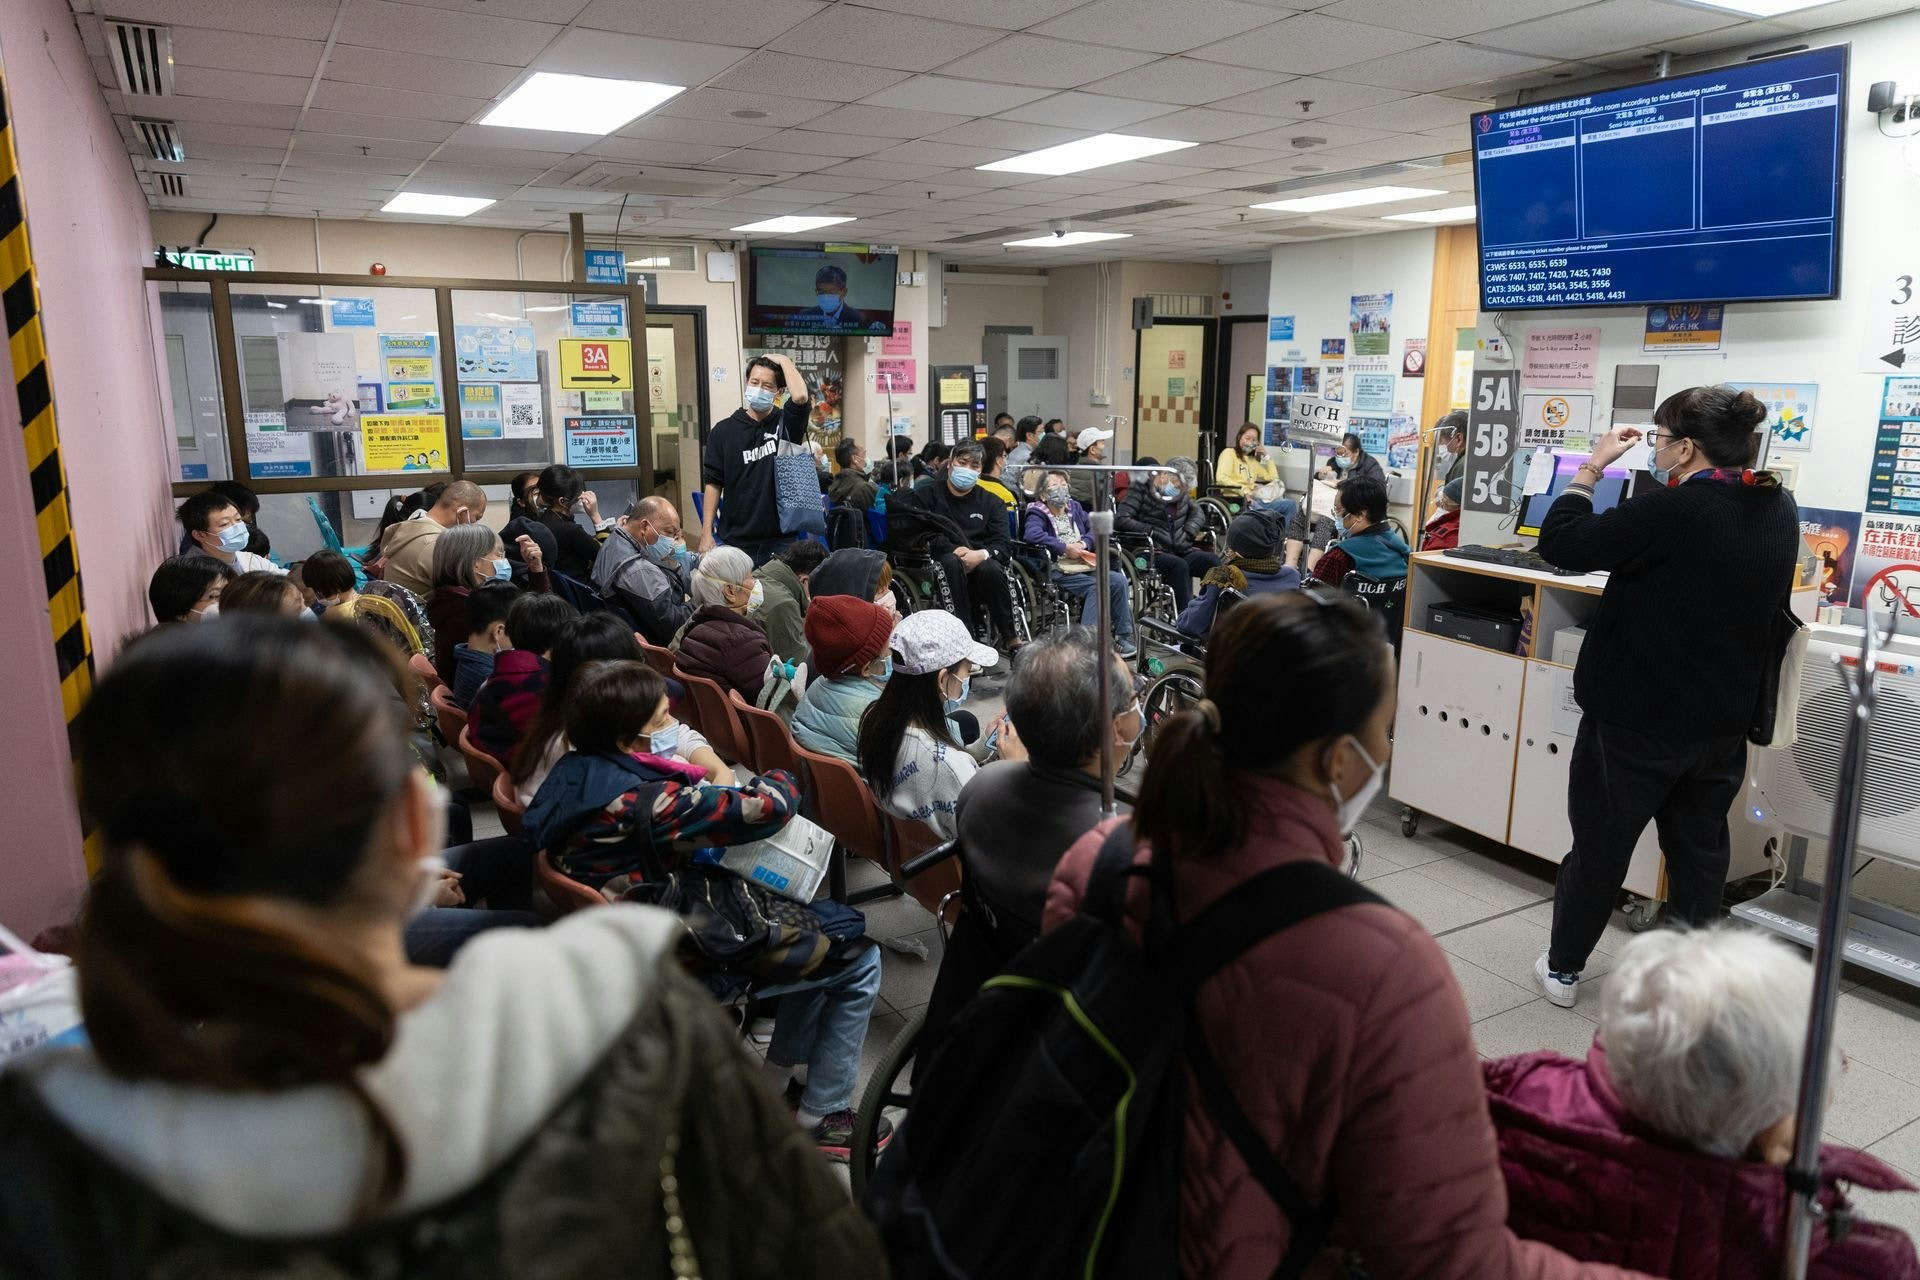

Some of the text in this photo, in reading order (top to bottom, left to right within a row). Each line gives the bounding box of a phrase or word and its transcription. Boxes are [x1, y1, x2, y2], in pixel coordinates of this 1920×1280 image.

[1540, 112, 1568, 122] designated
[1570, 106, 1604, 117] consultation
[1621, 97, 1650, 108] according
[1670, 88, 1700, 98] following
[1702, 84, 1728, 94] number
[1736, 92, 1800, 109] Non-Urgent (Cat. 5)
[1608, 120, 1644, 129] Semi-Urgent
[1508, 137, 1524, 146] Urgent
[1486, 263, 1508, 272] C3WS:
[1508, 262, 1527, 270] 6533,
[1528, 260, 1548, 269] 6535,
[1486, 274, 1508, 282] C4WS:
[1509, 273, 1527, 282] 7407,
[1548, 271, 1568, 279] 7420,
[1570, 269, 1590, 278] 7425,
[1592, 268, 1611, 276] 7430
[1507, 284, 1526, 292] 3504,
[1527, 283, 1546, 292] 3507,
[1548, 282, 1568, 291] 3543,
[1569, 281, 1589, 290] 3545,
[1591, 280, 1610, 288] 3556
[1891, 275, 1913, 305] 3
[1488, 296, 1526, 305] CAT4,CAT5:
[1527, 294, 1545, 303] 4218,
[1546, 294, 1564, 302] 4411,
[1565, 293, 1584, 302] 4421,
[1586, 292, 1606, 300] 5418,
[1893, 316, 1920, 345] 診
[584, 347, 608, 364] 3A
[1477, 378, 1511, 411] 5A
[1301, 403, 1340, 421] UCH
[1474, 424, 1508, 457] 5B
[1472, 471, 1504, 505] 5C
[1358, 583, 1386, 594] UCH
